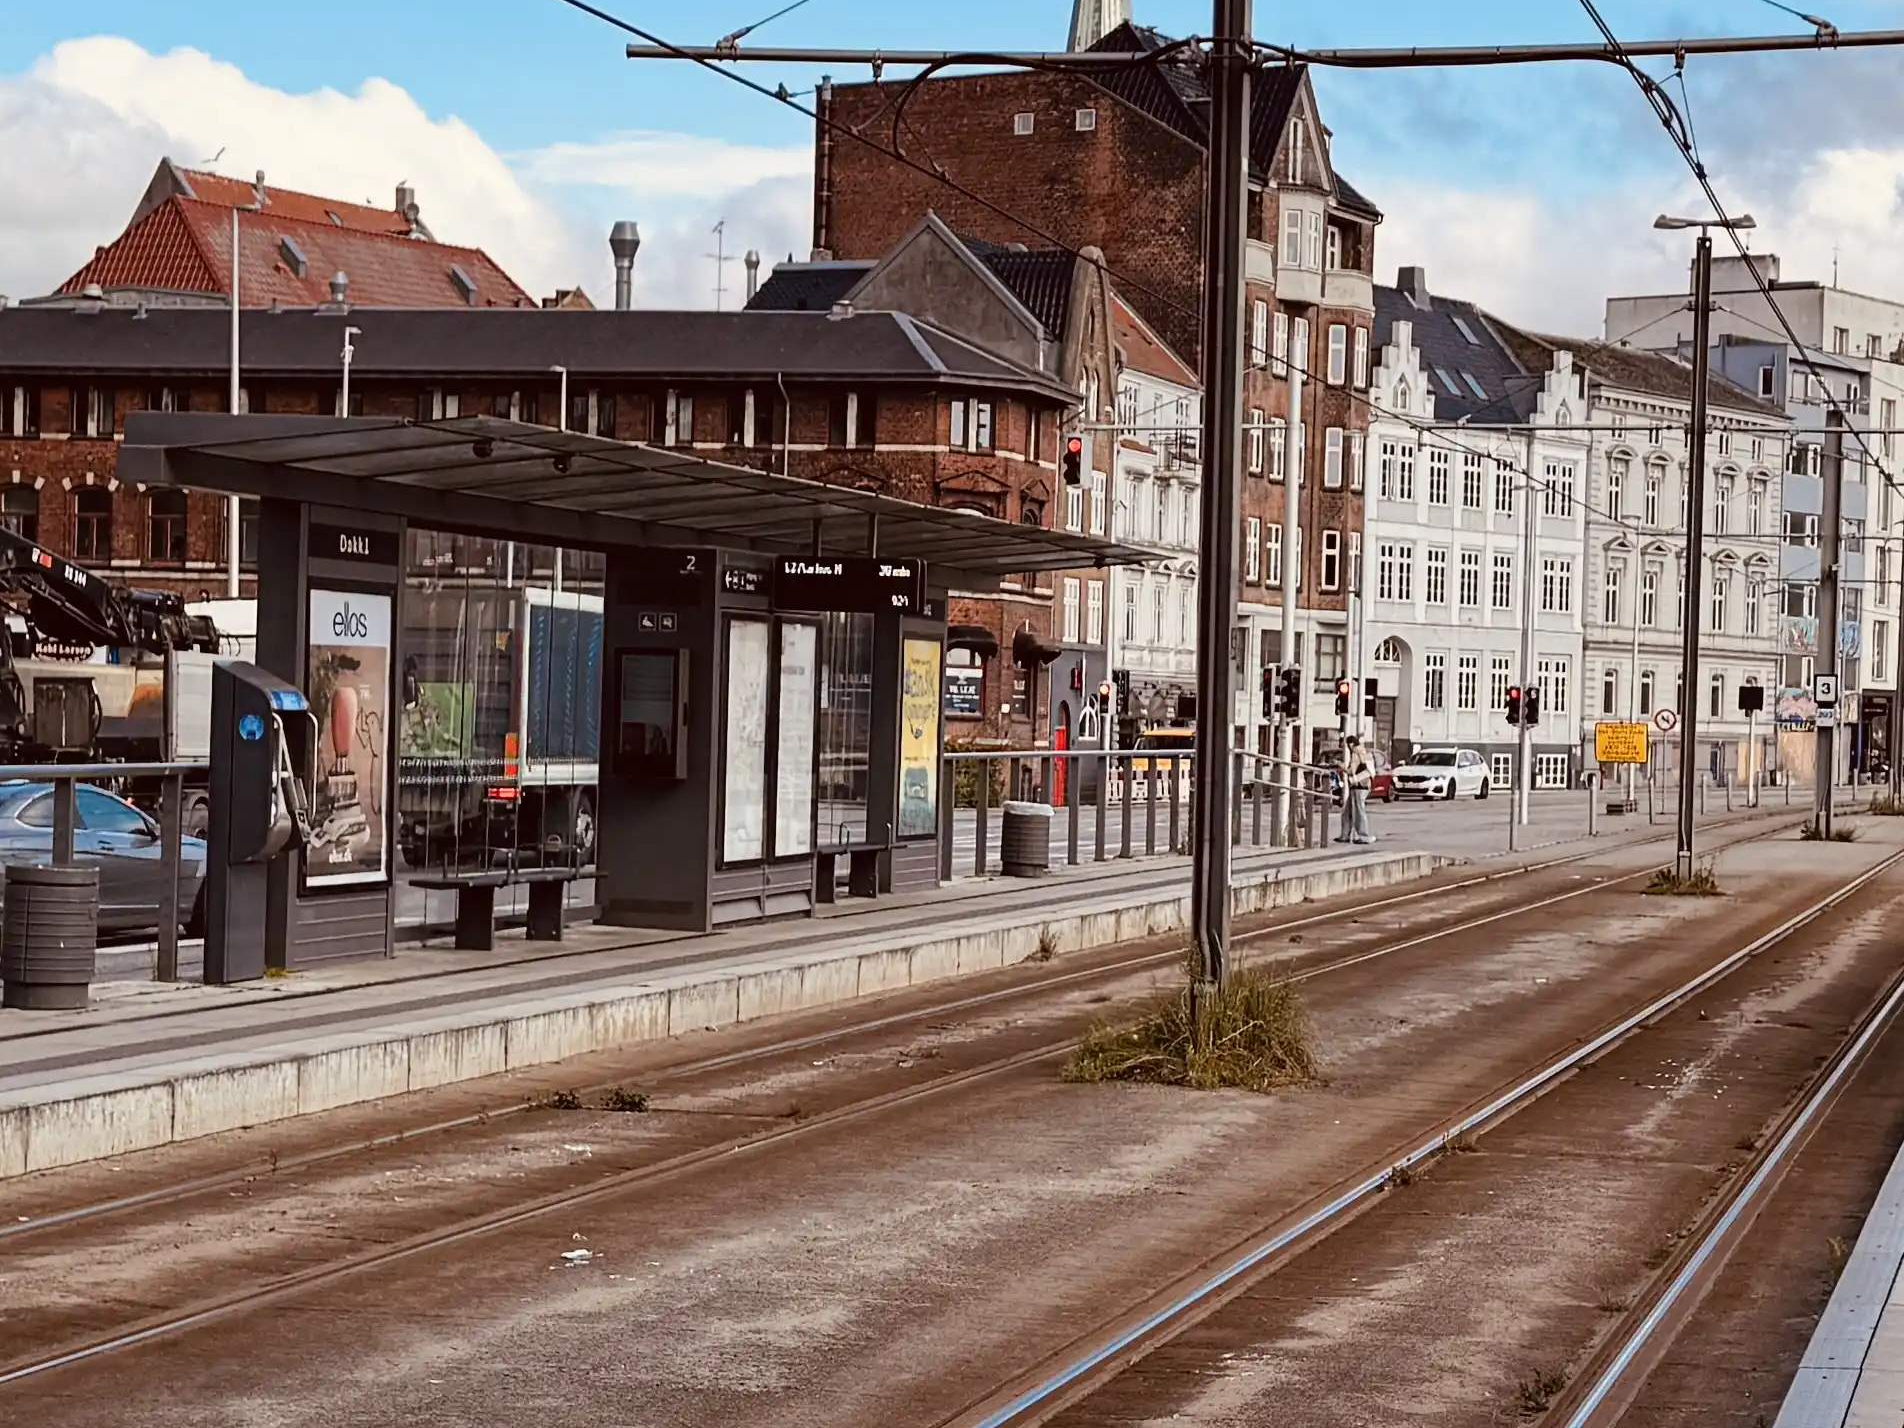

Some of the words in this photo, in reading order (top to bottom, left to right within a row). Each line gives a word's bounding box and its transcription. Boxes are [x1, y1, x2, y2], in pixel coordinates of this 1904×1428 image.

[686, 555, 696, 570] 2
[332, 600, 368, 638] ellos
[1821, 682, 1831, 695] 3
